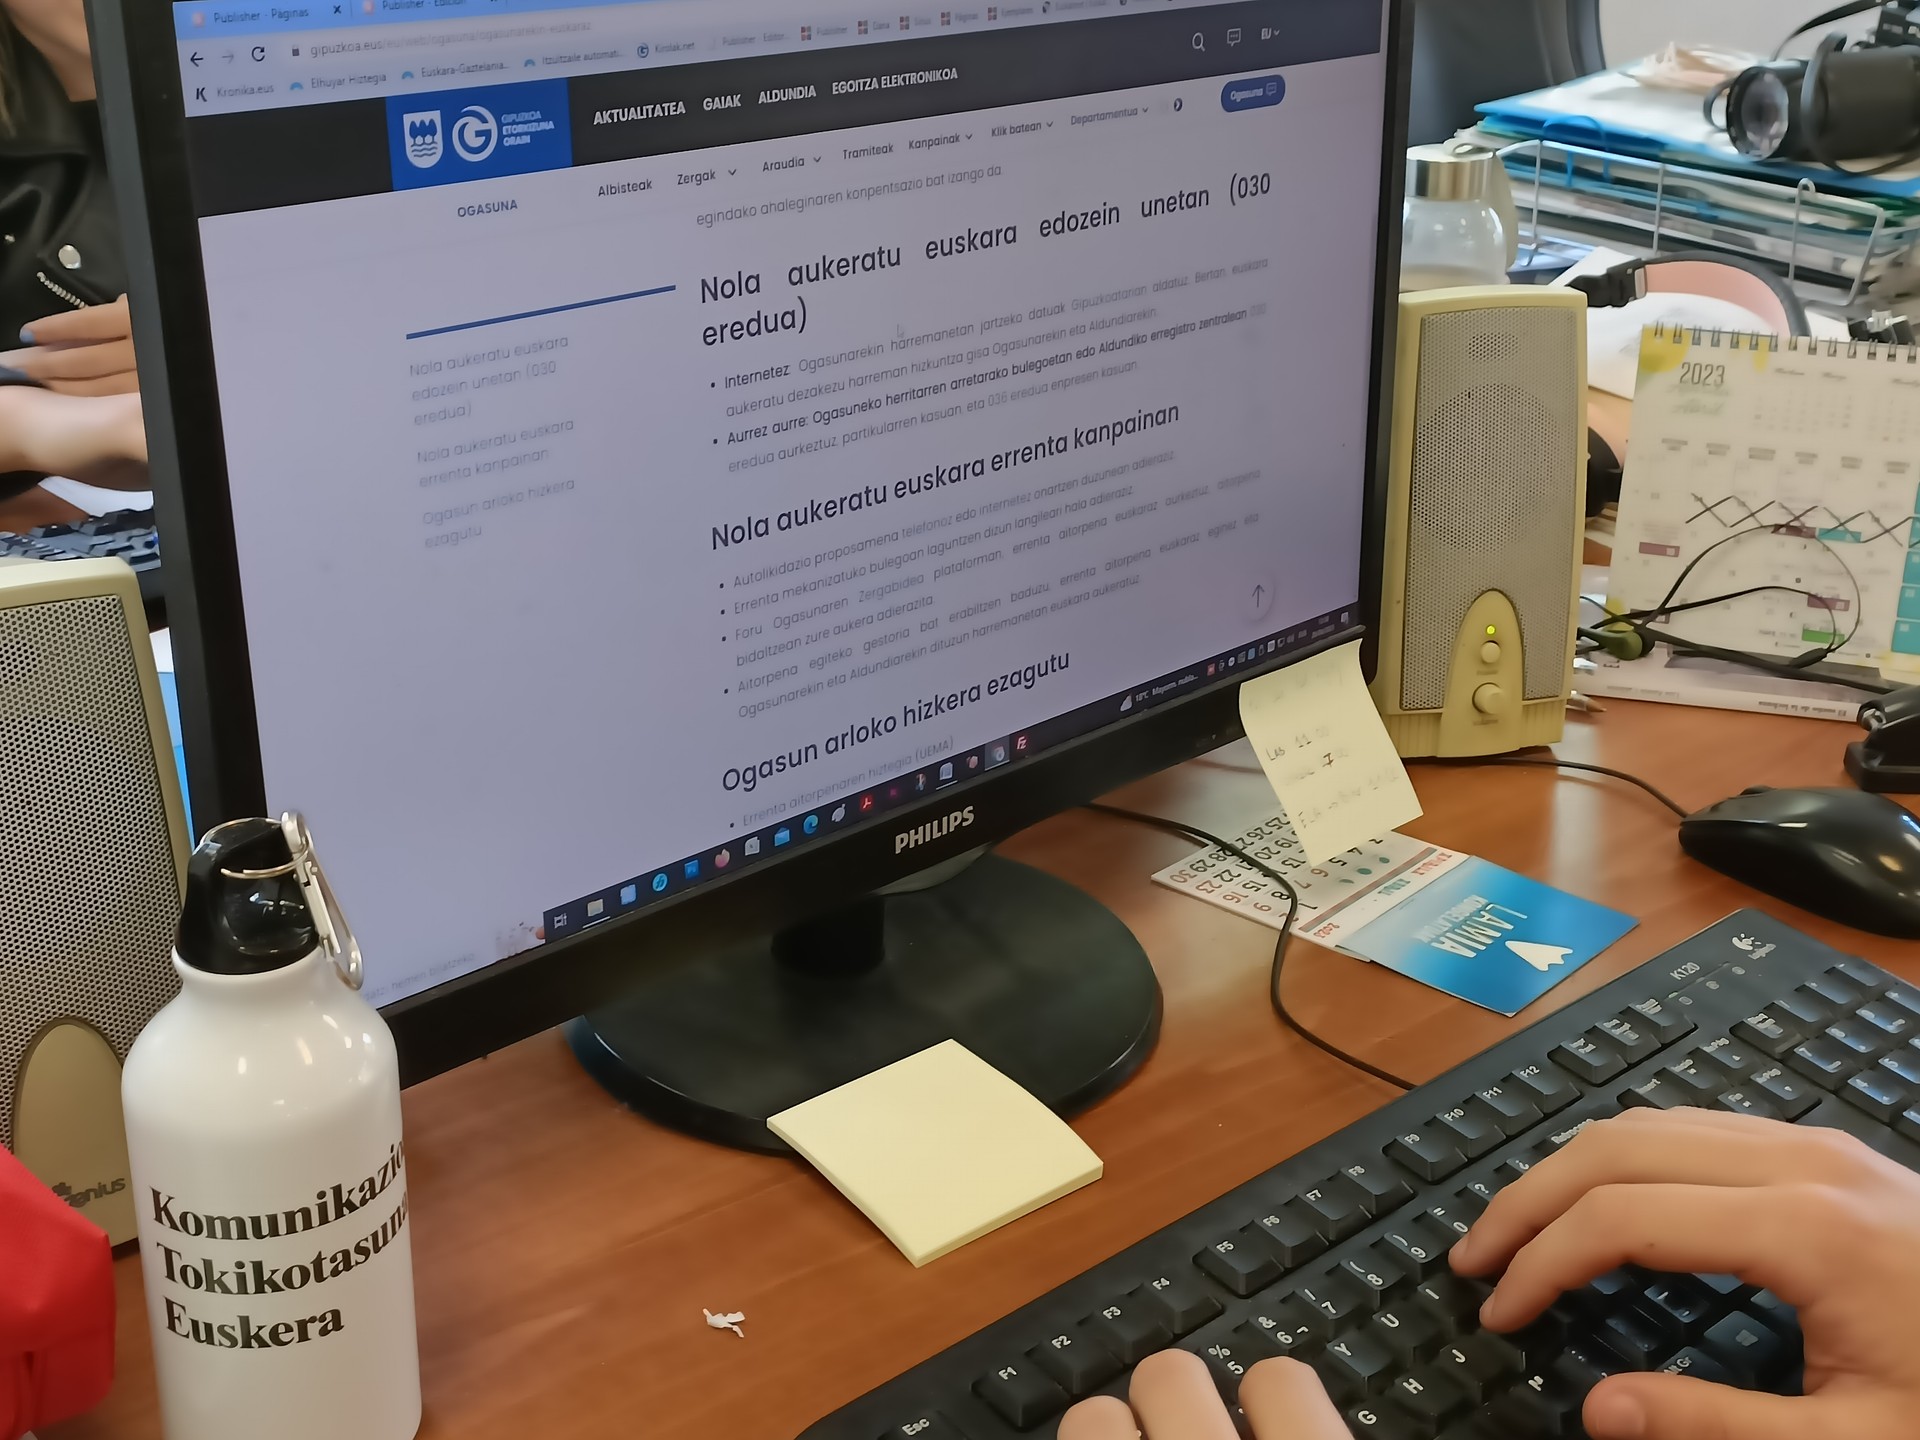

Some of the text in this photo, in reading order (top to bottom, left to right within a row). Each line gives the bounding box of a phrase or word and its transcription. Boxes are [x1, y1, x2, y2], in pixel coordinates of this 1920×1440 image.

[217, 85, 274, 98] Kronika.eus
[593, 67, 958, 126] AKTUALITATEA GAIAK ALDUNDIA EGOITZA ELEKTRONIKOA
[597, 106, 1138, 197] Albisteak Zergak Araudia Tramiteak Kanpainak Klik batean Departamentua
[457, 199, 518, 218] OGASUNA
[696, 166, 984, 228] egindako ahaleginaren konpentsazio bat izango
[700, 172, 1270, 304] Nola aukeratu euskara edozein unetan (030
[702, 295, 807, 346] eredua)
[798, 285, 1147, 374] Ogasunarekin harremanetan jartzeko datuak Gipuzkoatarian
[410, 336, 569, 377] Nola aukeratu euskara
[726, 328, 1066, 417] aukeratu dezakezu harreman hizkuntza gisa Ogasunarekin
[1679, 361, 1726, 387] 2023
[411, 360, 557, 402] edozein unetan (030
[727, 425, 768, 445] Aurrez
[813, 398, 882, 426] Ogasuneko
[885, 382, 947, 407] herritarren
[950, 367, 1009, 391] arretarako
[1012, 352, 1072, 375] bulegoetan
[1075, 345, 1095, 360] edo
[1098, 333, 1148, 354] Aldundiko
[1150, 322, 1196, 342] erregistro
[1199, 309, 1247, 330] zentralean
[414, 402, 472, 426] eredua)
[842, 417, 918, 446] partikularren
[1051, 370, 1099, 393] enpresen
[417, 419, 574, 464] Nola aukeratu euskara
[419, 448, 550, 488] errenta kanpainan
[711, 404, 1180, 551] Nola aukeratu euskara errenta kanpainan
[422, 478, 575, 526] Ogasun arloko hizkera
[733, 463, 1129, 588] Autolikidazio proposamena telefonoz internetez onartzen duzunean
[734, 498, 1087, 614] Errenta mekanizatuko bulegoan laguntzen dizun langileari hala
[735, 573, 925, 641] Foru Ogasunaren Zergabidea
[736, 614, 874, 667] bidaltzean zure aukera
[738, 597, 1002, 694] Aitorpena egiteko gestoria erabiltzen
[737, 604, 1048, 719] Ogasunarekin Aldundiarekin dituzun harremanetan
[722, 652, 1070, 792] Ogasun arloko hizkera ezagutu
[743, 803, 787, 827] Errenta
[789, 772, 865, 809] aitorpenaren
[915, 736, 954, 760] (UEMA)
[895, 805, 975, 855] PHILIPS
[1169, 858, 1216, 884] 29 30
[1195, 879, 1222, 894] 23
[1271, 890, 1290, 901] 8
[1430, 903, 1528, 958] LAMIA
[1670, 962, 1700, 980] K120
[1520, 1065, 1540, 1078] F12
[1482, 1086, 1503, 1100] F11
[1443, 1108, 1465, 1122] F10
[1404, 1133, 1420, 1145] F9
[150, 1139, 404, 1240] Komunikazio
[1348, 1165, 1365, 1177] F8
[1306, 1189, 1321, 1201] F7
[1263, 1215, 1280, 1227] F6
[1216, 1240, 1234, 1253] F5
[1152, 1277, 1170, 1291] F4
[163, 1295, 344, 1349] Euskera
[1103, 1305, 1122, 1320] F3
[1381, 1313, 1400, 1328] U
[1051, 1334, 1072, 1349] F2
[1334, 1342, 1353, 1357] Y
[1452, 1349, 1466, 1363] J
[998, 1366, 1018, 1381] F1
[1402, 1378, 1424, 1394] H
[901, 1417, 930, 1437] Esc
[1358, 1410, 1377, 1426] G
